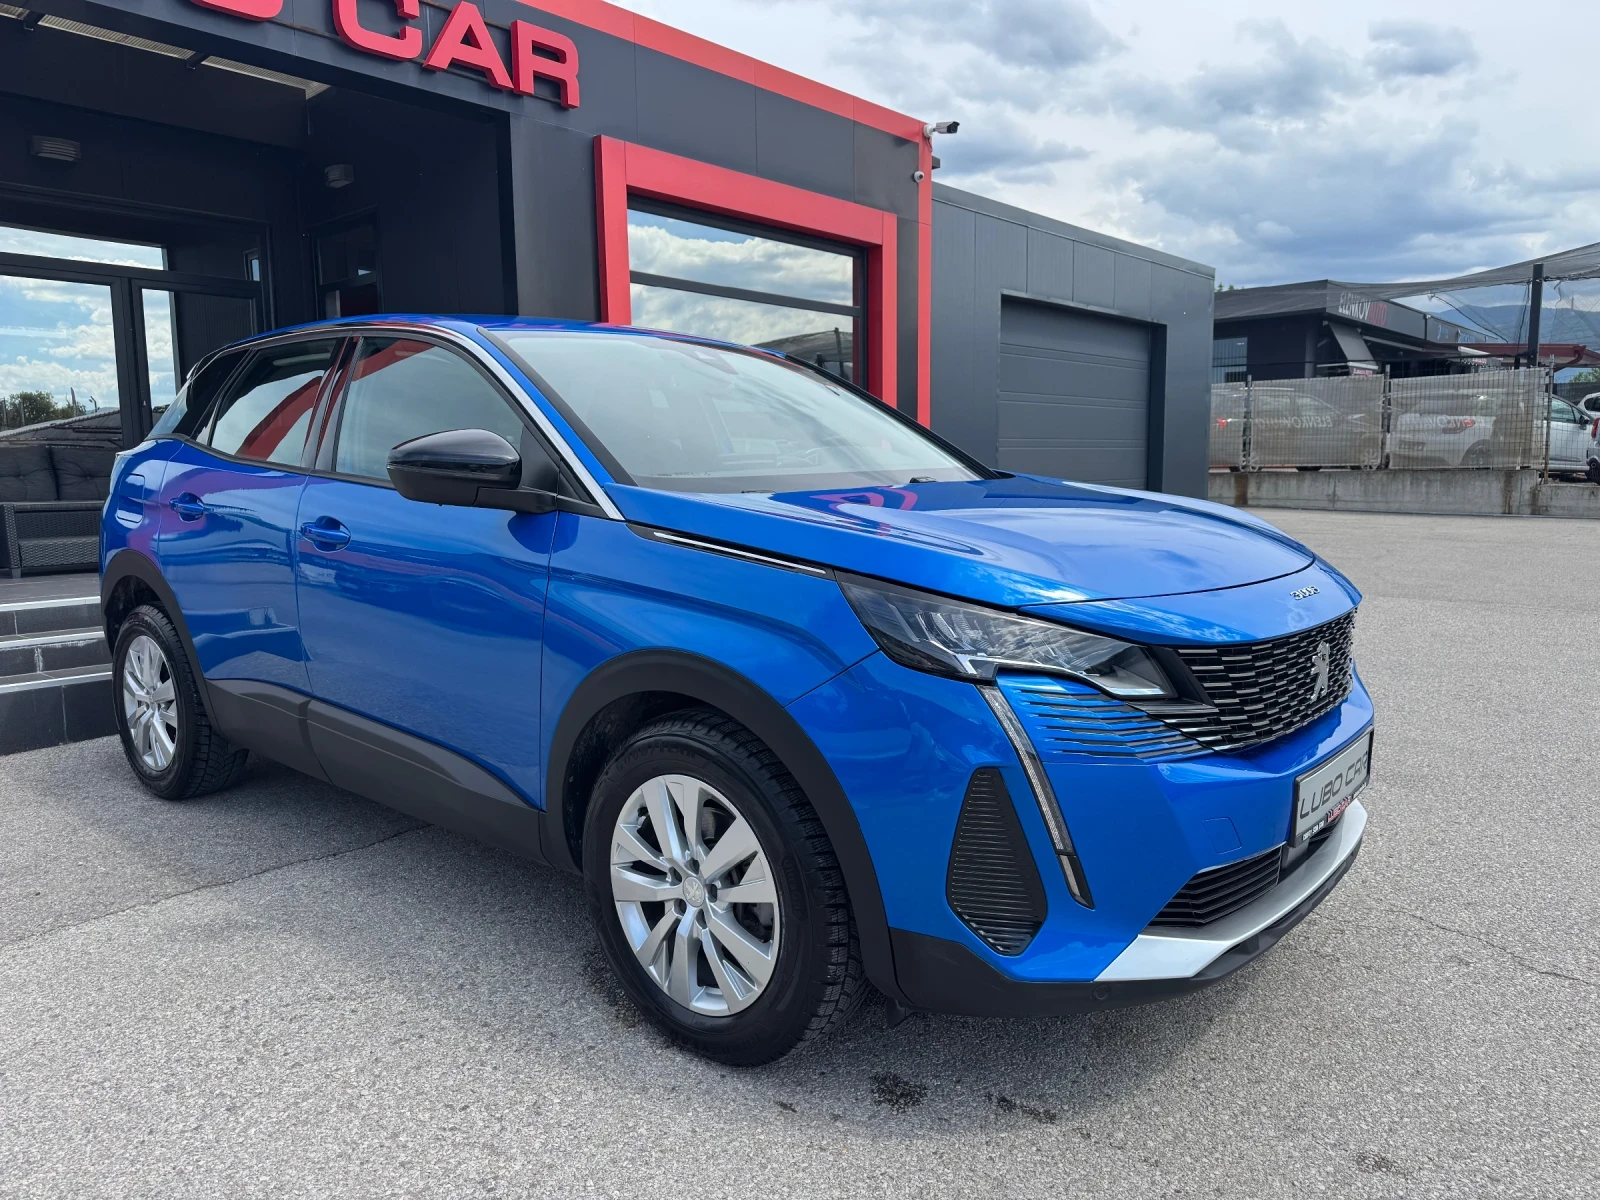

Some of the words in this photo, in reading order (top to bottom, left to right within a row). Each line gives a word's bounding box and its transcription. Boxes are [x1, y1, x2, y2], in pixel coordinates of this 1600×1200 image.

[333, 0, 580, 109] CAR
[1290, 585, 1320, 600] 3008
[1299, 772, 1343, 820] LUBO
[1345, 750, 1368, 787] CAR
